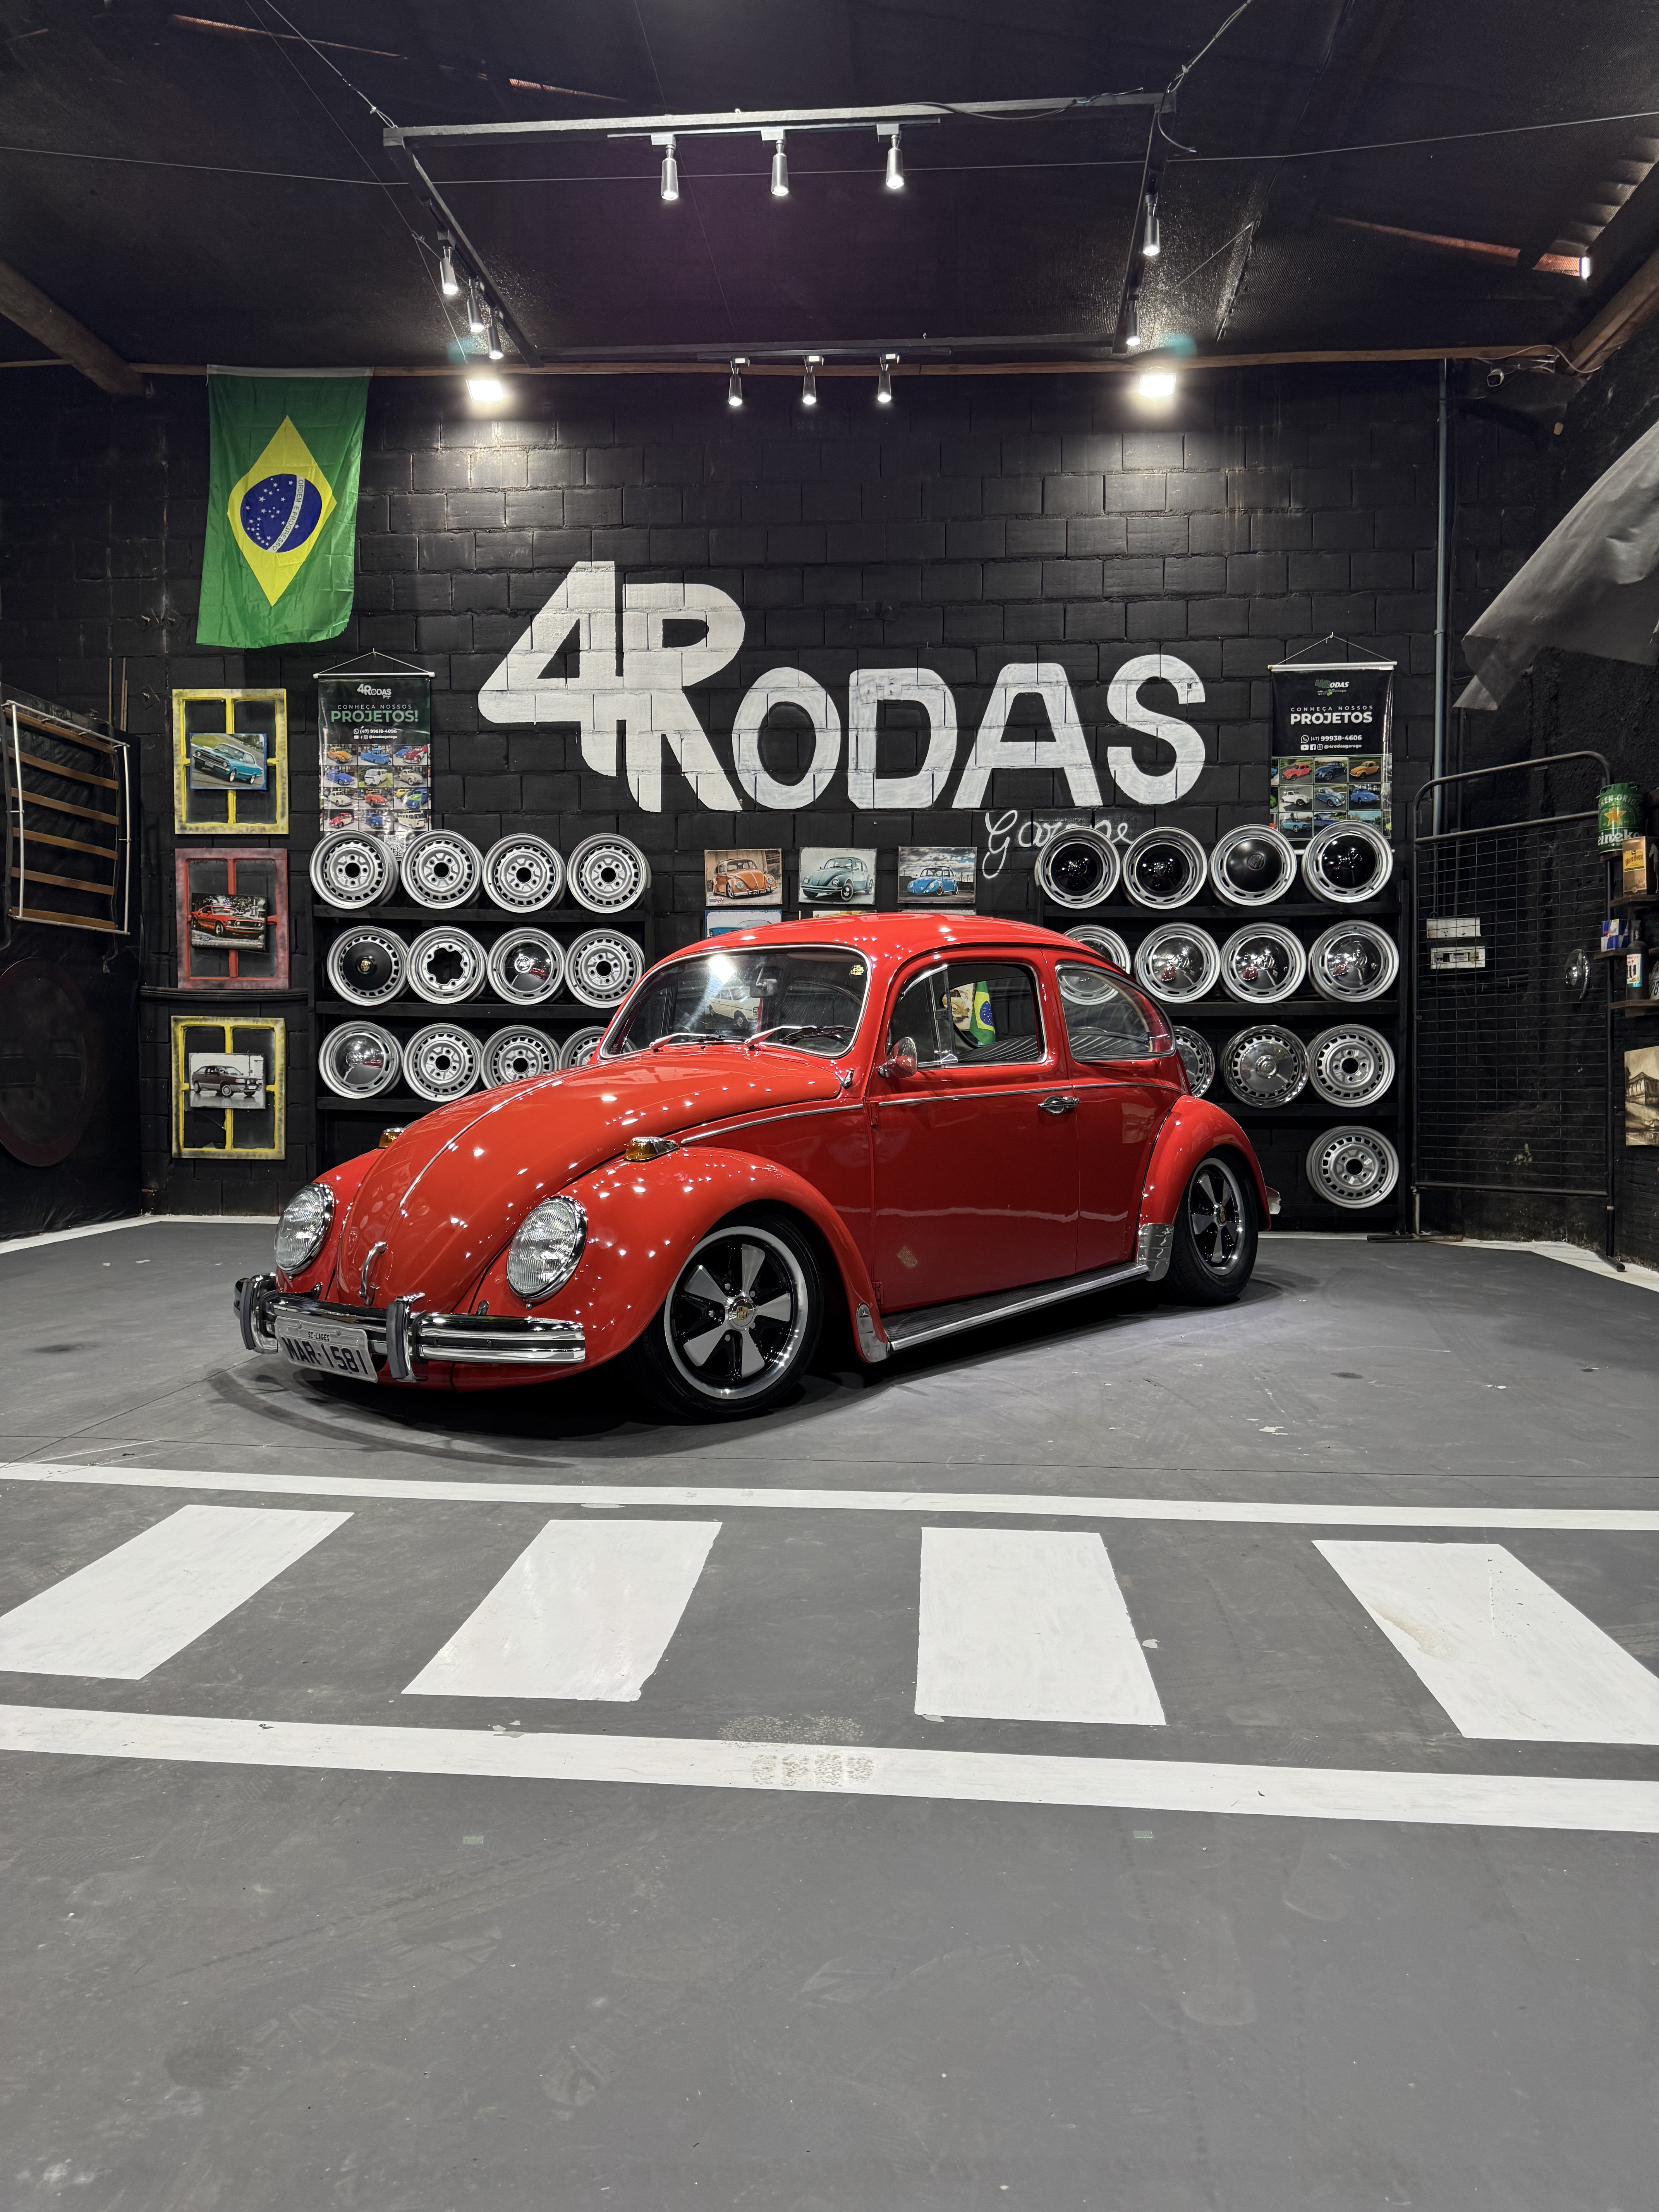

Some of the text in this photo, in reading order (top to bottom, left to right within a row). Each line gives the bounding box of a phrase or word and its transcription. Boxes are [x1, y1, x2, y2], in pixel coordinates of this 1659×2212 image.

[295, 479, 304, 503] ORDEM
[273, 511, 297, 551] PROGRESSO
[478, 561, 1205, 812] 4RODAS
[331, 710, 418, 723] PROJETOS!
[1290, 711, 1373, 725] PROJETOS
[308, 1331, 330, 1341] SC-LAGES
[282, 1336, 368, 1375] MAR-1581
